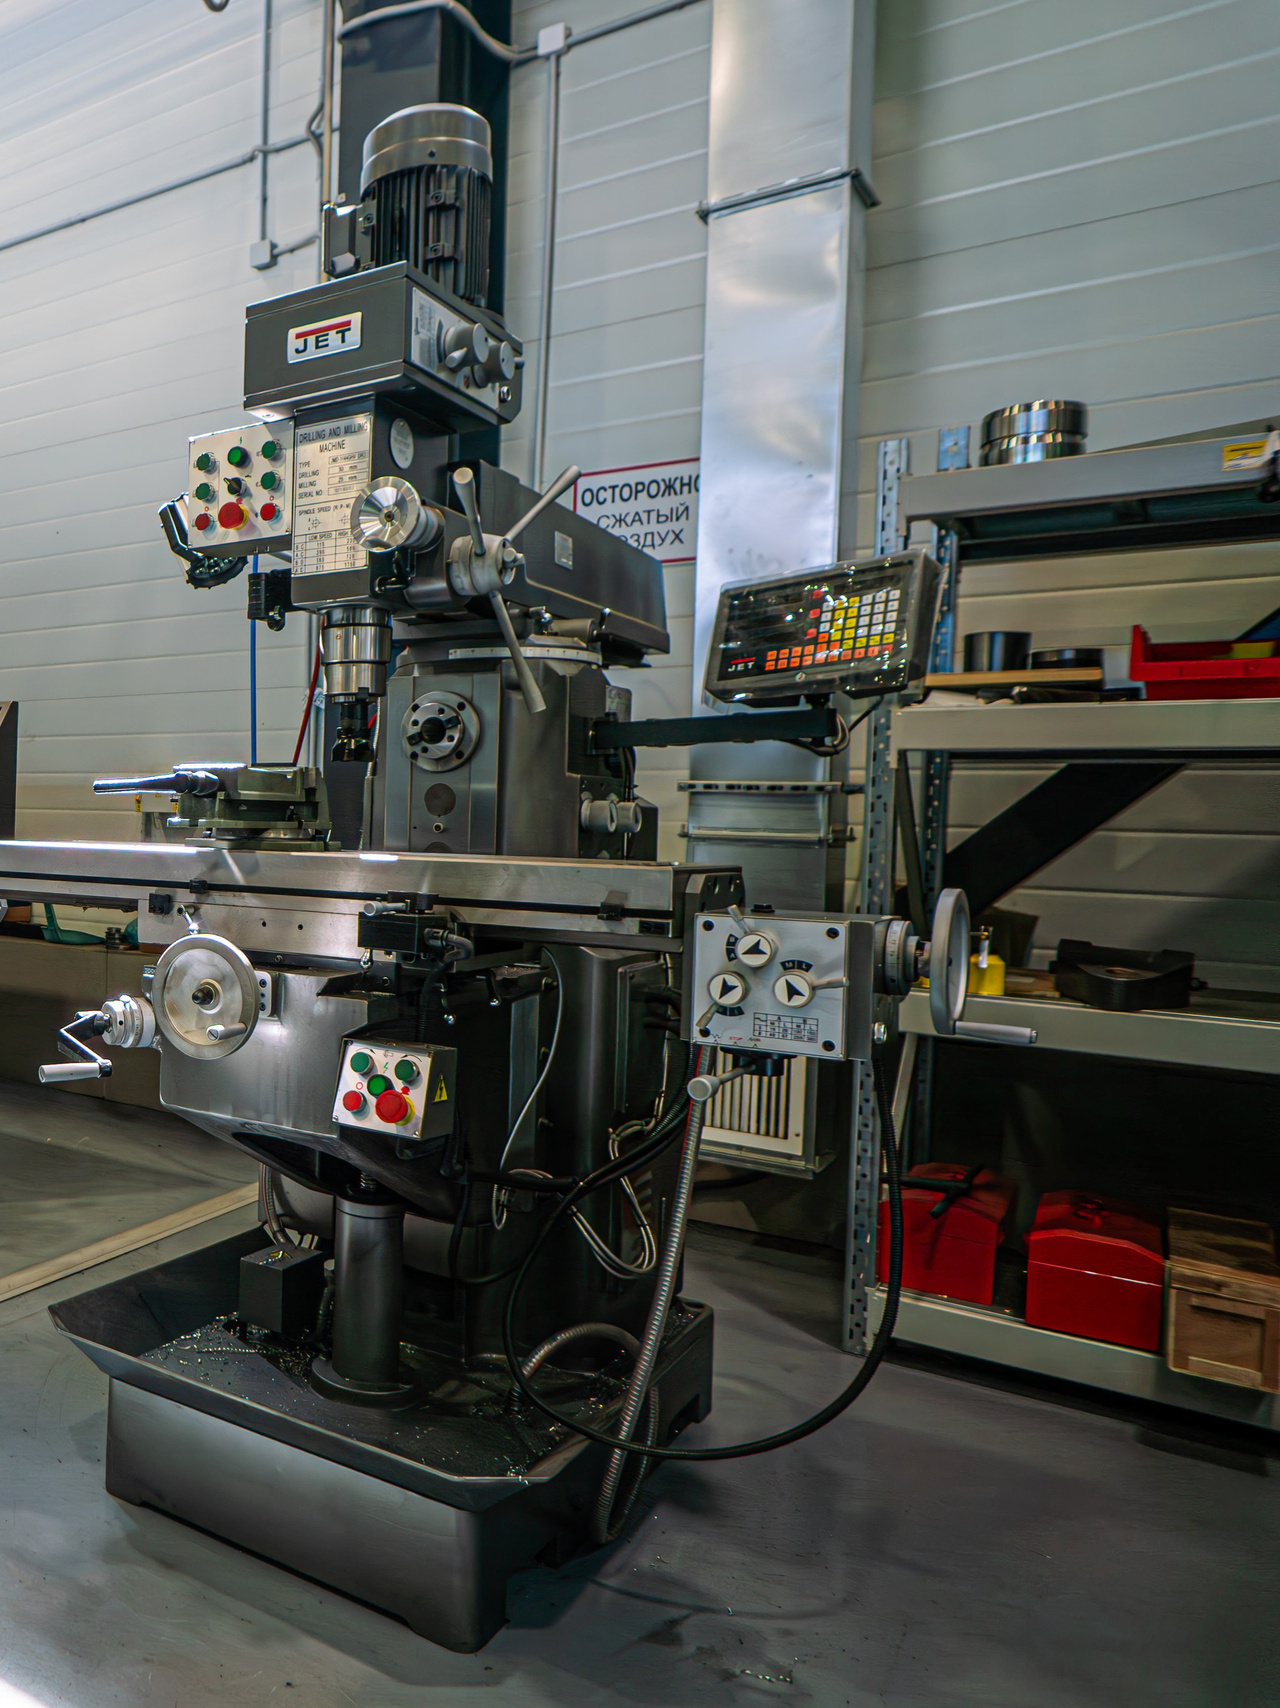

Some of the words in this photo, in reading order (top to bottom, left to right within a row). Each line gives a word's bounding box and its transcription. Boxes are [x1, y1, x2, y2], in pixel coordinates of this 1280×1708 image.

[295, 327, 351, 354] JET
[299, 430, 325, 443] DRILLING
[329, 426, 341, 437] AND
[344, 420, 368, 434] MILLING
[320, 440, 345, 453] MACHINE
[299, 470, 319, 479] DRILLING
[299, 480, 316, 488] MILLING
[298, 491, 314, 499] SERIAL
[299, 508, 315, 516] SPINDLE
[728, 662, 754, 671] JET
